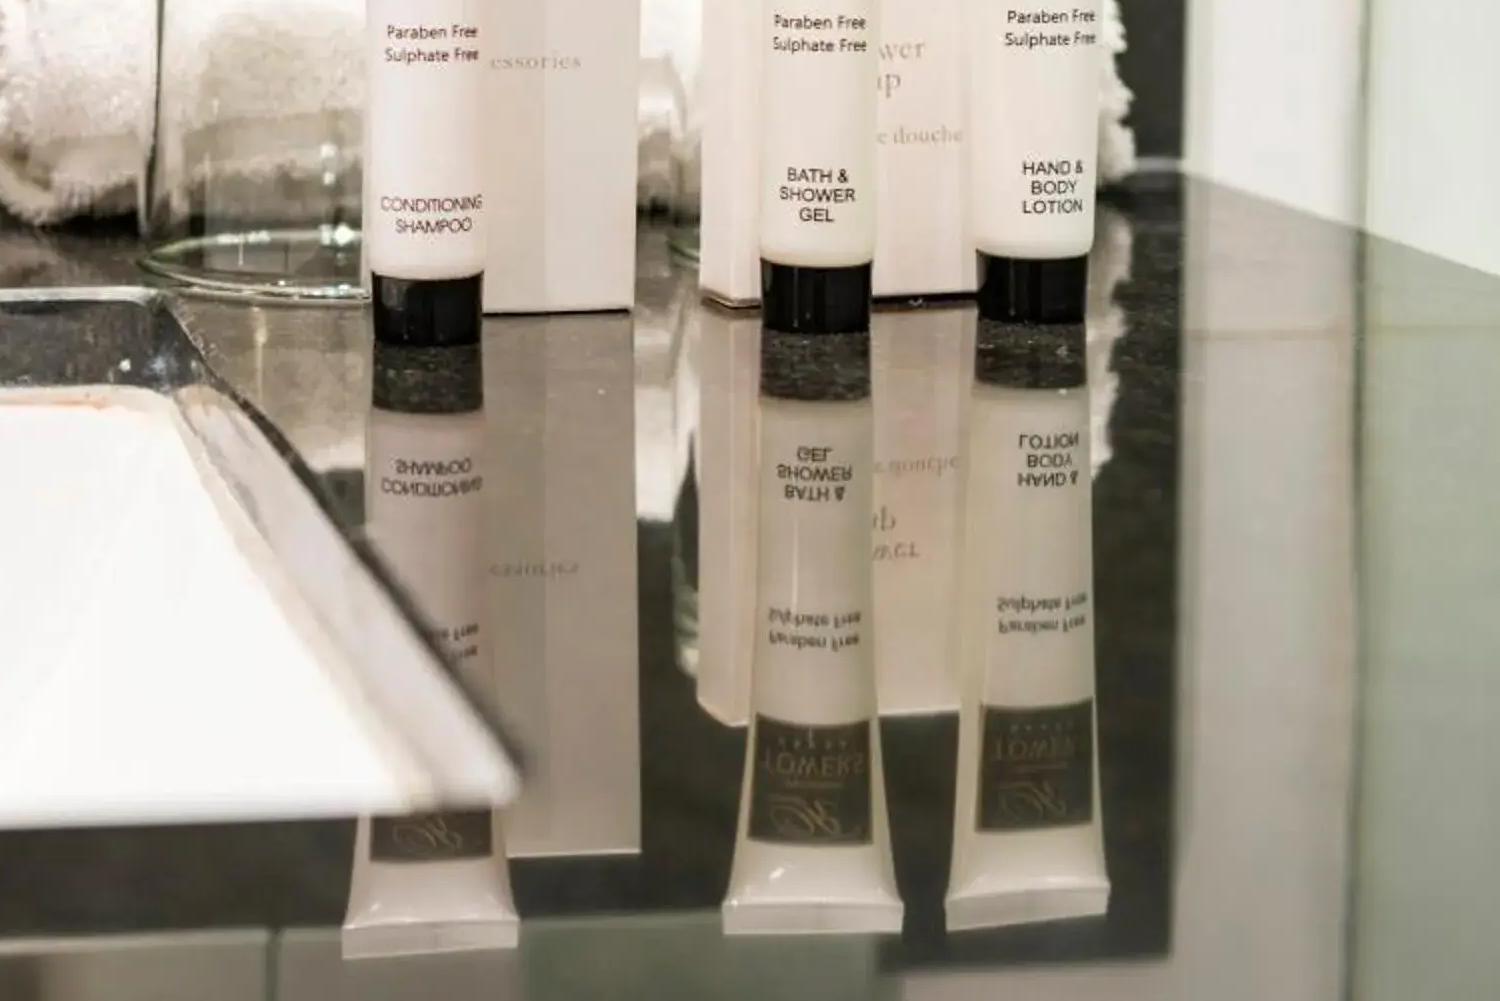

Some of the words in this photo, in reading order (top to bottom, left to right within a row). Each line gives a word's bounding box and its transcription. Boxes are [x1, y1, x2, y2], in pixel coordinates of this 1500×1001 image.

[774, 14, 833, 30] Paraben
[837, 15, 867, 30] Free
[1007, 10, 1069, 25] Paraben
[1072, 9, 1096, 23] Free
[387, 25, 447, 40] Paraben
[452, 24, 478, 38] Free
[1005, 32, 1070, 49] Sulphate
[1073, 31, 1097, 45] Free
[772, 36, 835, 55] Sulphate
[839, 38, 868, 52] Free
[385, 47, 449, 64] Sulphate
[454, 47, 480, 61] Free
[893, 124, 964, 145] douche
[787, 167, 833, 184] BATH
[837, 168, 849, 184] &
[1022, 161, 1072, 176] HAND
[1075, 160, 1084, 175] &
[779, 186, 856, 203] SHOWER
[1031, 180, 1077, 196] BODY
[380, 194, 483, 214] CONDITIONING
[1022, 199, 1083, 215] LOTION
[799, 207, 835, 223] GEL
[395, 217, 473, 234] SHAMPOO
